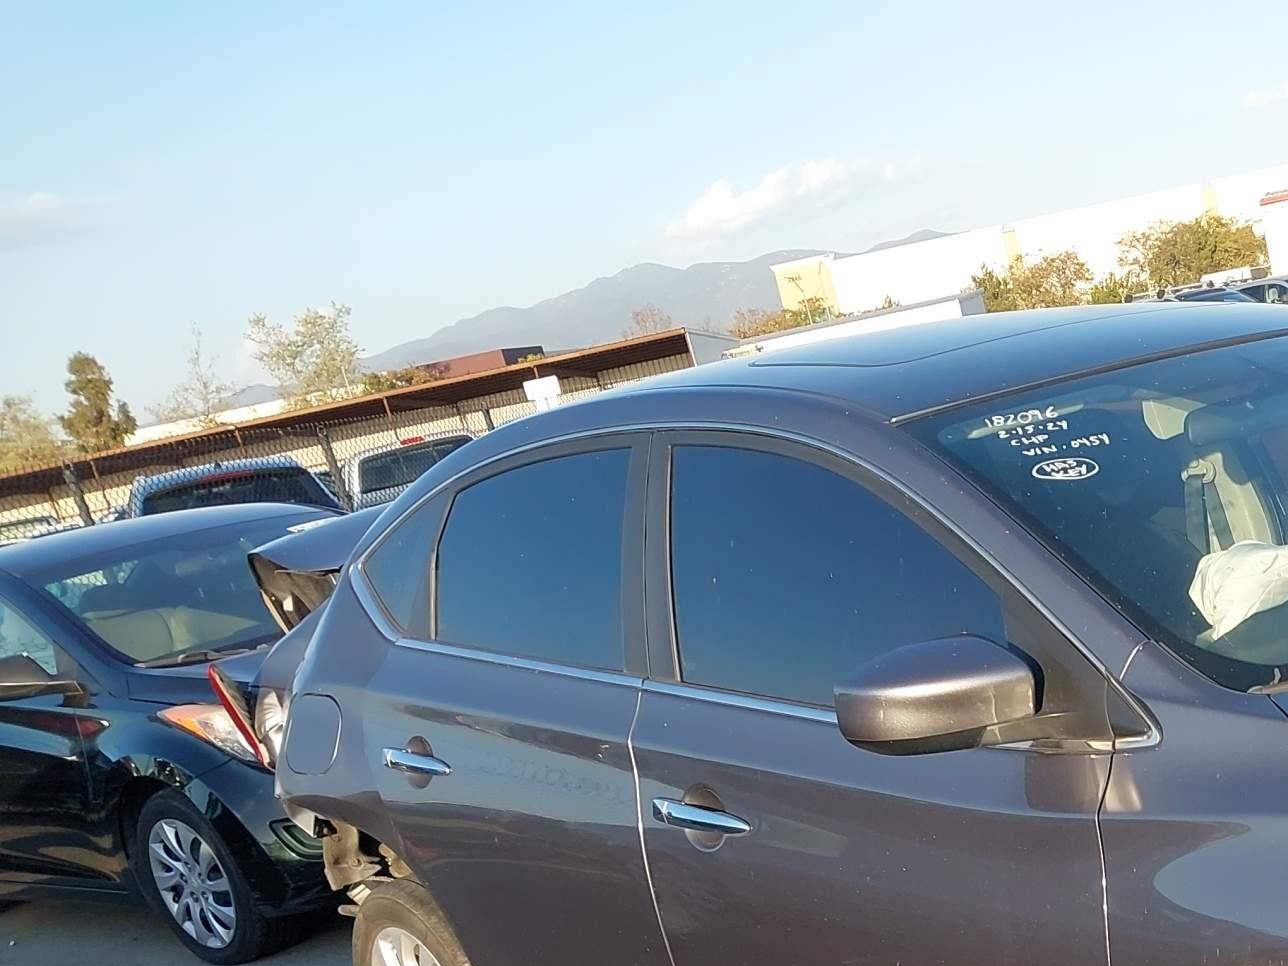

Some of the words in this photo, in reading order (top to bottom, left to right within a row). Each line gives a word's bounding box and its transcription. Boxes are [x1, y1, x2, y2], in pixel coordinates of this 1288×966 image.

[984, 405, 1059, 428] 182096
[1041, 460, 1077, 472] HAS
[1050, 464, 1088, 477] KEY
